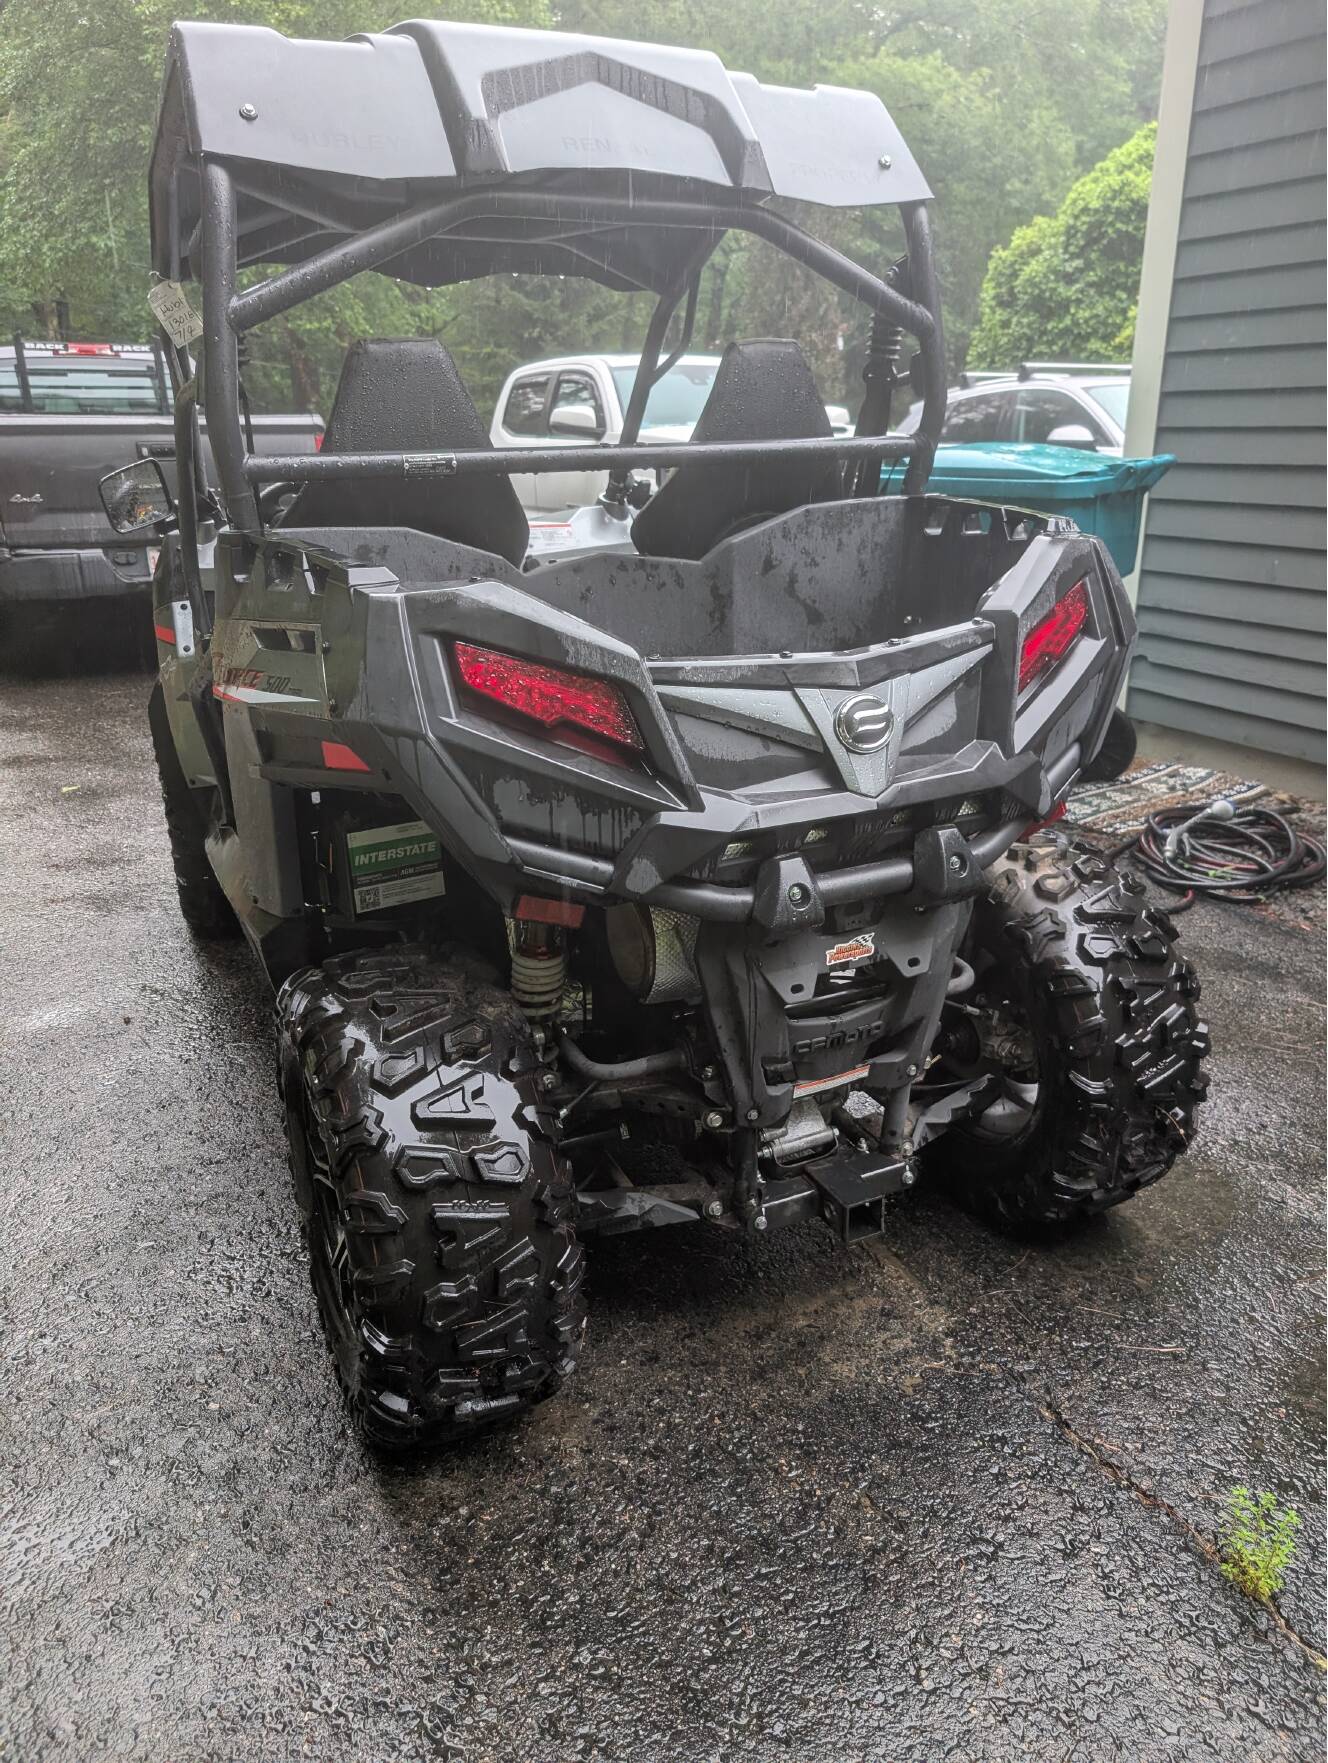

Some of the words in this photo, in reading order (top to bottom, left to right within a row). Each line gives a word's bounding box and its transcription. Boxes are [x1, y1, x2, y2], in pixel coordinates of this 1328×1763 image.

[24, 342, 65, 350] BACK
[112, 344, 151, 352] RACK
[354, 841, 437, 866] INTERSTATE
[792, 1020, 884, 1053] CFMOTO
